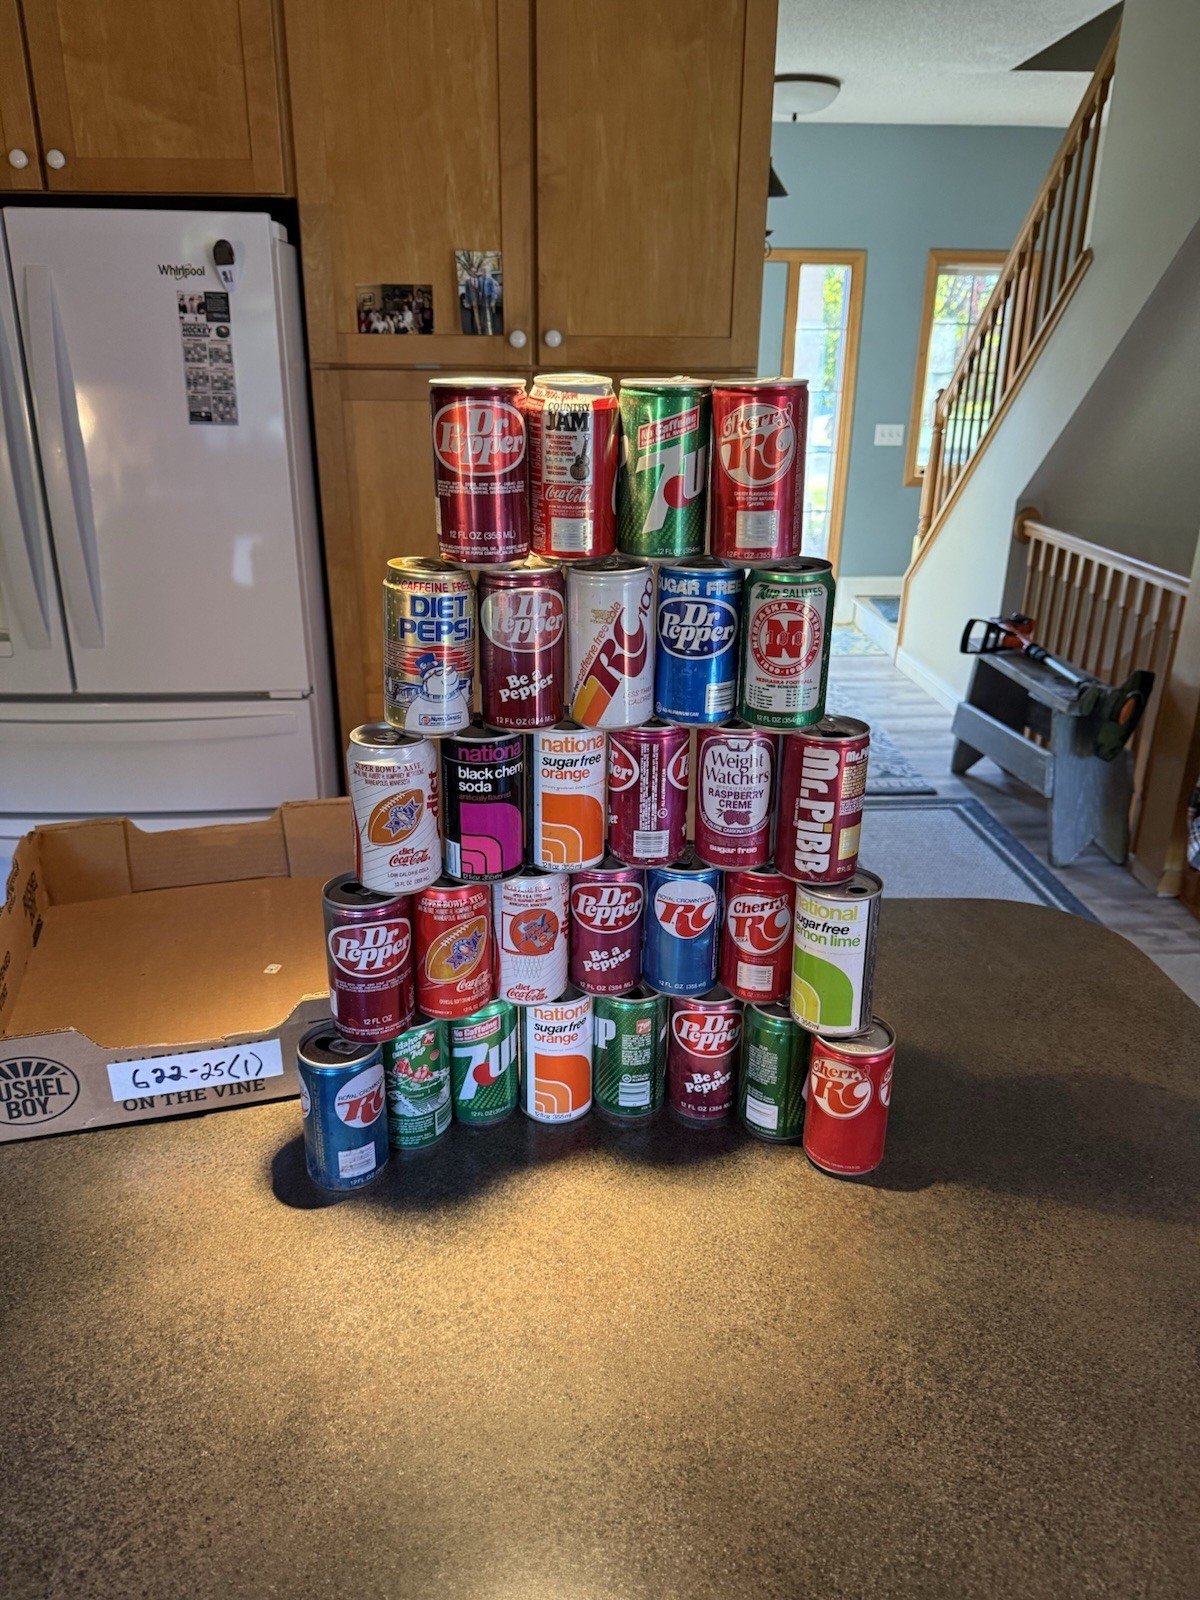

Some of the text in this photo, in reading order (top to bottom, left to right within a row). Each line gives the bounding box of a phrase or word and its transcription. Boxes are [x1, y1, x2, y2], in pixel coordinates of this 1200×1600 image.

[158, 264, 205, 279] Whirlpool
[548, 402, 590, 412] COUNTRY
[463, 408, 509, 436] Dr
[545, 411, 590, 431] JAM
[722, 401, 793, 436] Cherry
[439, 422, 523, 465] Pepper
[721, 427, 792, 481] RC
[636, 444, 706, 534] 7U
[449, 530, 457, 539] 12
[458, 531, 468, 540] FL
[469, 531, 482, 540] OZ
[401, 580, 471, 592] CAFFEINE FREE
[706, 579, 742, 596] FREE
[782, 586, 823, 598] SALUTES
[410, 595, 467, 618] DIET
[513, 595, 552, 618] Dr
[680, 603, 720, 627] Dr
[400, 617, 471, 641] PEPSI
[492, 606, 563, 643] Pepper
[661, 611, 735, 650] Pepper
[752, 602, 788, 648] NEBRASKA
[577, 601, 621, 681] caffeine free cola
[583, 577, 653, 698] RC 100
[499, 673, 553, 703] Pepper
[506, 669, 542, 689] Be a
[755, 676, 784, 684] NEBRASKA
[496, 716, 504, 724] 12
[458, 741, 522, 762] nationa
[541, 735, 604, 754] nationa
[354, 762, 374, 772] SUPER
[404, 762, 421, 771] XXVI
[542, 754, 602, 770] sugar free
[711, 750, 763, 773] Weight
[458, 766, 493, 780] black
[541, 768, 590, 782] orange
[705, 765, 770, 785] Watchers
[459, 781, 492, 793] soda
[708, 787, 764, 800] RASPBERRY
[718, 799, 752, 809] CREME
[398, 847, 415, 856] diet
[709, 844, 757, 854] sugar free
[399, 869, 418, 877] CALORIE
[596, 887, 632, 907] Dr
[658, 893, 674, 902] ROYAL
[733, 894, 789, 914] Cherry
[576, 892, 642, 926] Pepper
[657, 900, 715, 938] RC
[730, 908, 789, 951] RC
[796, 911, 850, 935] sugar free
[360, 926, 399, 948] Dr
[830, 934, 861, 947] lime
[336, 933, 409, 971] Pepper
[583, 948, 632, 972] Pepper
[589, 946, 621, 962] Be a
[515, 983, 530, 991] diet
[382, 1014, 392, 1022] OZ
[534, 1001, 590, 1020] nationa
[454, 1020, 498, 1037] No Caffeine
[534, 1016, 587, 1035] sugar free
[700, 1015, 734, 1033] Dr
[534, 1032, 579, 1045] orange
[679, 1018, 741, 1051] Pepper
[691, 1070, 722, 1084] Be a
[811, 1059, 871, 1081] Cherry
[0, 1077, 70, 1102] USHEL
[684, 1071, 732, 1094] Pepper
[123, 1079, 266, 1111] ON THE VINE
[338, 1092, 357, 1101] ROYAL
[811, 1072, 870, 1114] RC
[6, 1097, 49, 1119] BOY
